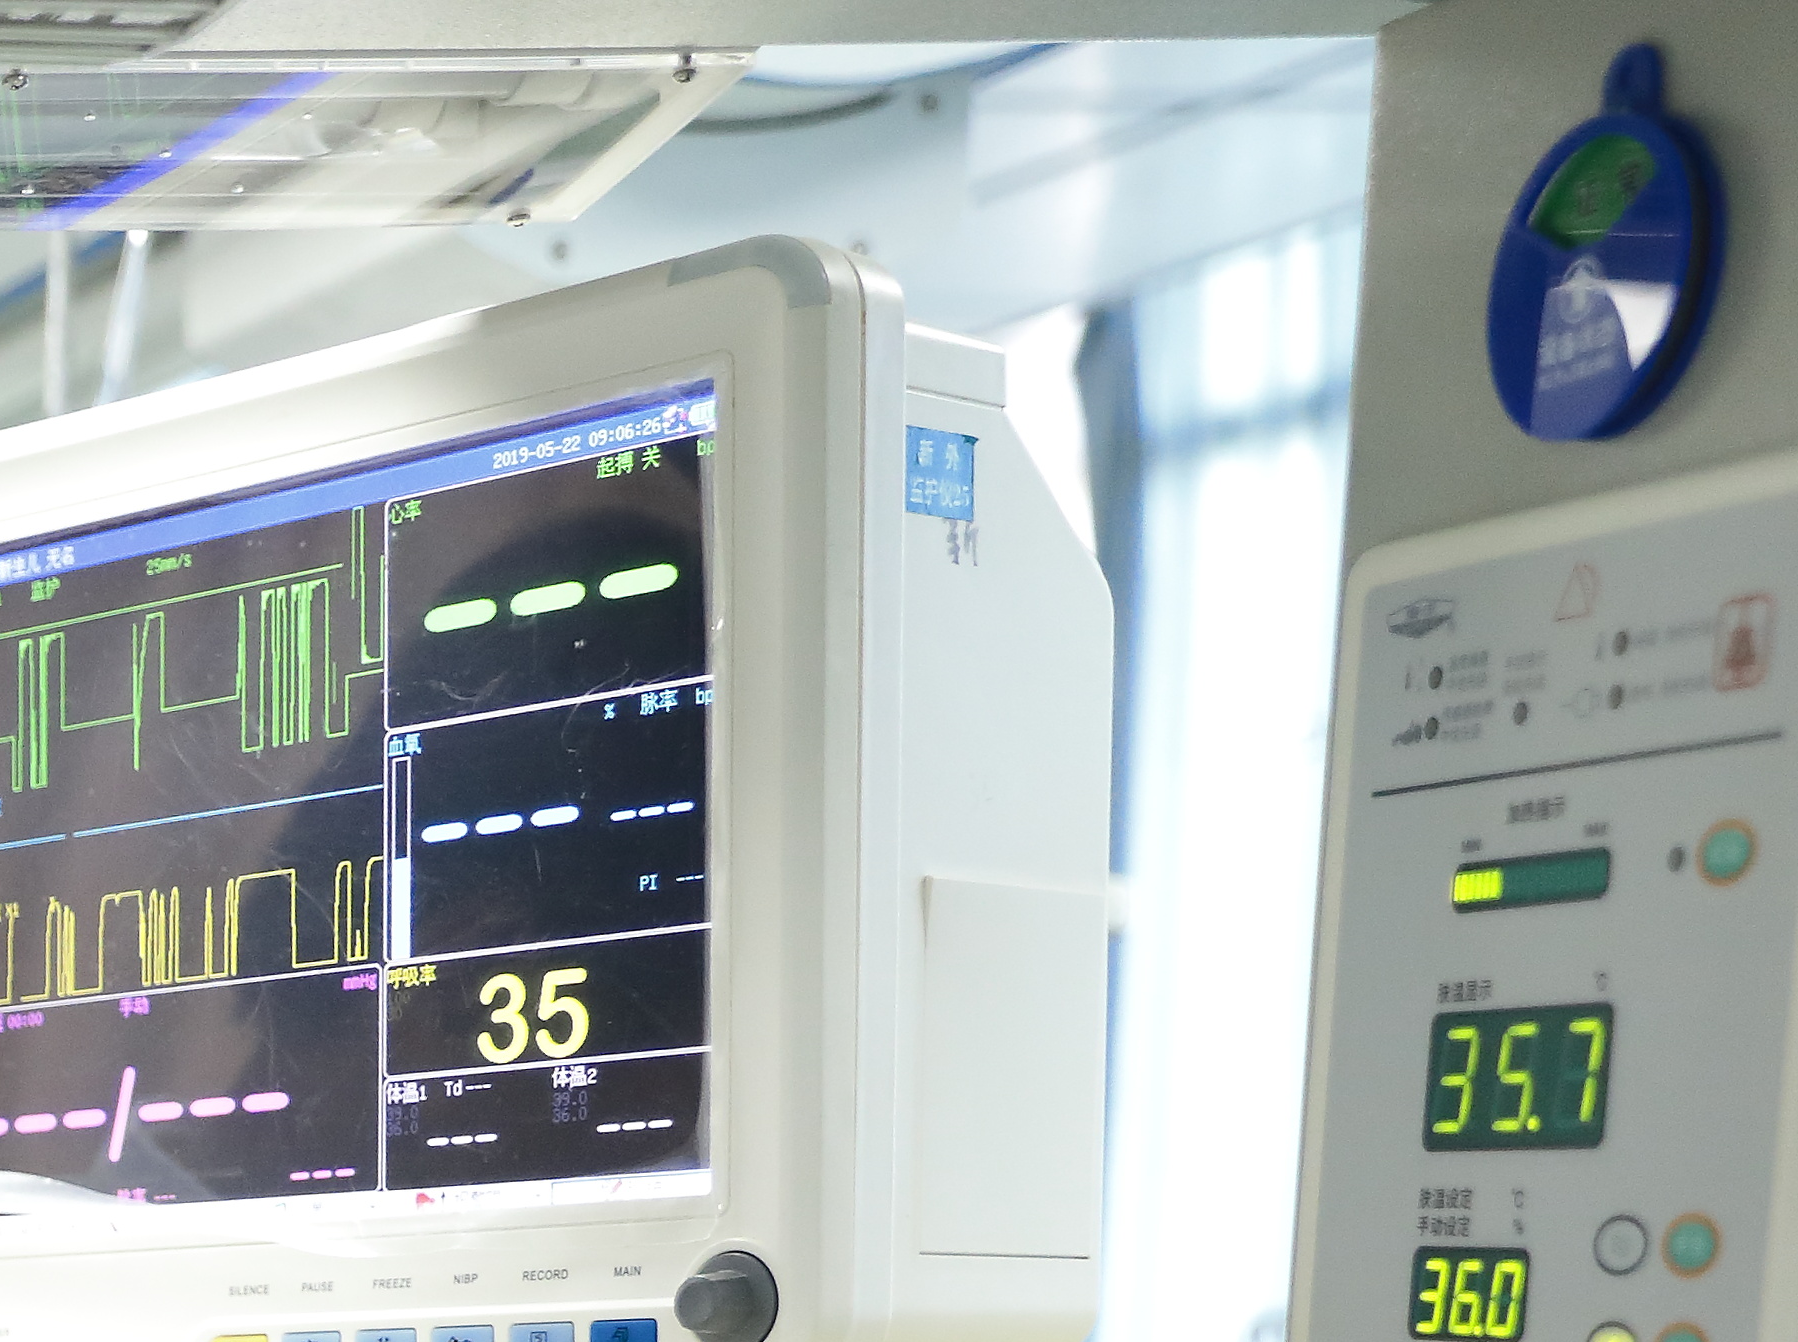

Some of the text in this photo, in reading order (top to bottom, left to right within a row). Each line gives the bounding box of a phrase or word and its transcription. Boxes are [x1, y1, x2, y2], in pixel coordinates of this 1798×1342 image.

[492, 418, 663, 470] 2019-05-22 09:06:26
[596, 446, 662, 480] 起搏 关
[389, 500, 422, 525] 心率
[146, 553, 193, 576] 25mm/s
[603, 702, 617, 720] %
[639, 688, 679, 716] 脉率
[388, 732, 422, 757] 血氧
[639, 873, 659, 891] PI
[386, 964, 437, 989] 呼吸率
[476, 967, 591, 1065] 35
[551, 1065, 598, 1092] 体温2
[1432, 1017, 1607, 1135] 35.7
[386, 1082, 428, 1105] 体温1
[372, 1277, 413, 1291] FREEZE
[453, 1272, 480, 1286] NIBP
[522, 1268, 570, 1284] RECORD
[613, 1265, 643, 1279] MAIN
[228, 1283, 270, 1297] SILENCE
[300, 1281, 334, 1294] PAUSE
[1414, 1258, 1528, 1339] 36.0
